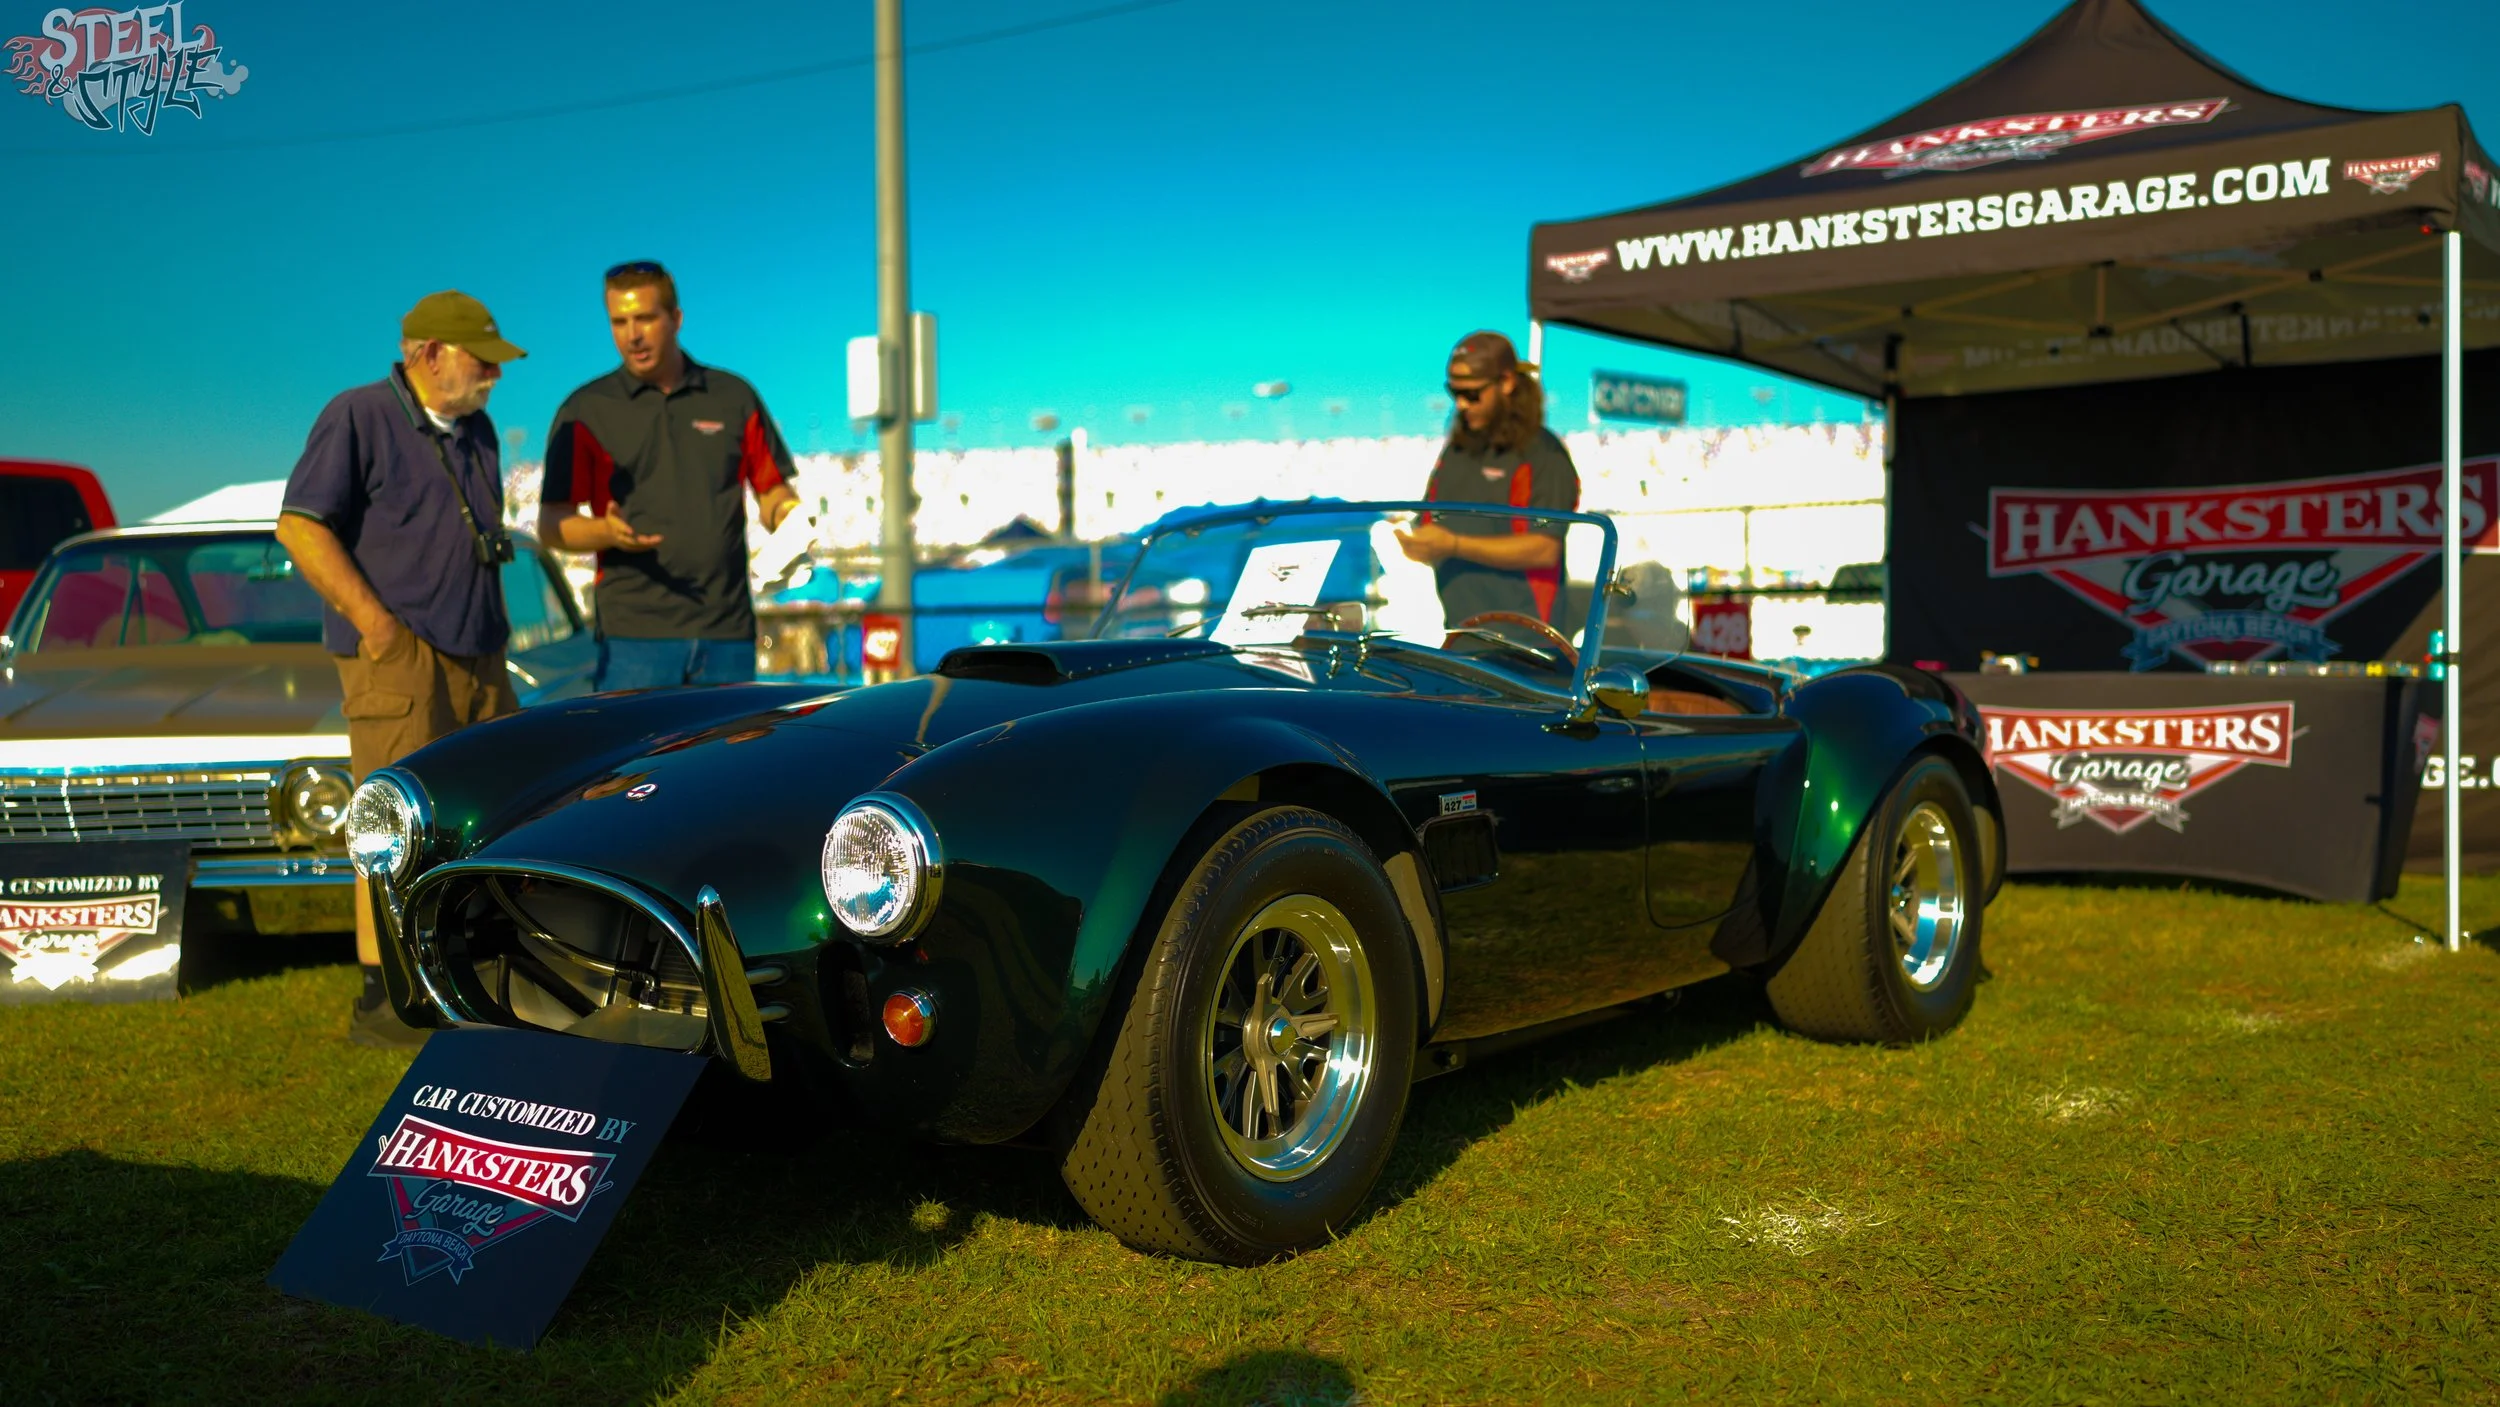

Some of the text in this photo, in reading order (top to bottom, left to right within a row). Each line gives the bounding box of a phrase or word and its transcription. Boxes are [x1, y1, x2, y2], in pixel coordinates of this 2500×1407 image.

[1616, 156, 2331, 271] WWW.HANKSTERSGARAGE.COM
[2003, 473, 2488, 561] HANKSTERS
[2123, 550, 2340, 615] Garage
[2051, 751, 2189, 792] Garage
[1443, 799, 1462, 813] 427
[9, 875, 132, 895] CUSTOMIZED
[137, 874, 163, 891] BY
[412, 1084, 637, 1144] CAR CUSTOMIZED BY
[381, 1128, 599, 1206] HANKSTERS
[403, 1180, 504, 1237] Garage
[399, 1231, 469, 1260] DAYTONA BEACH
